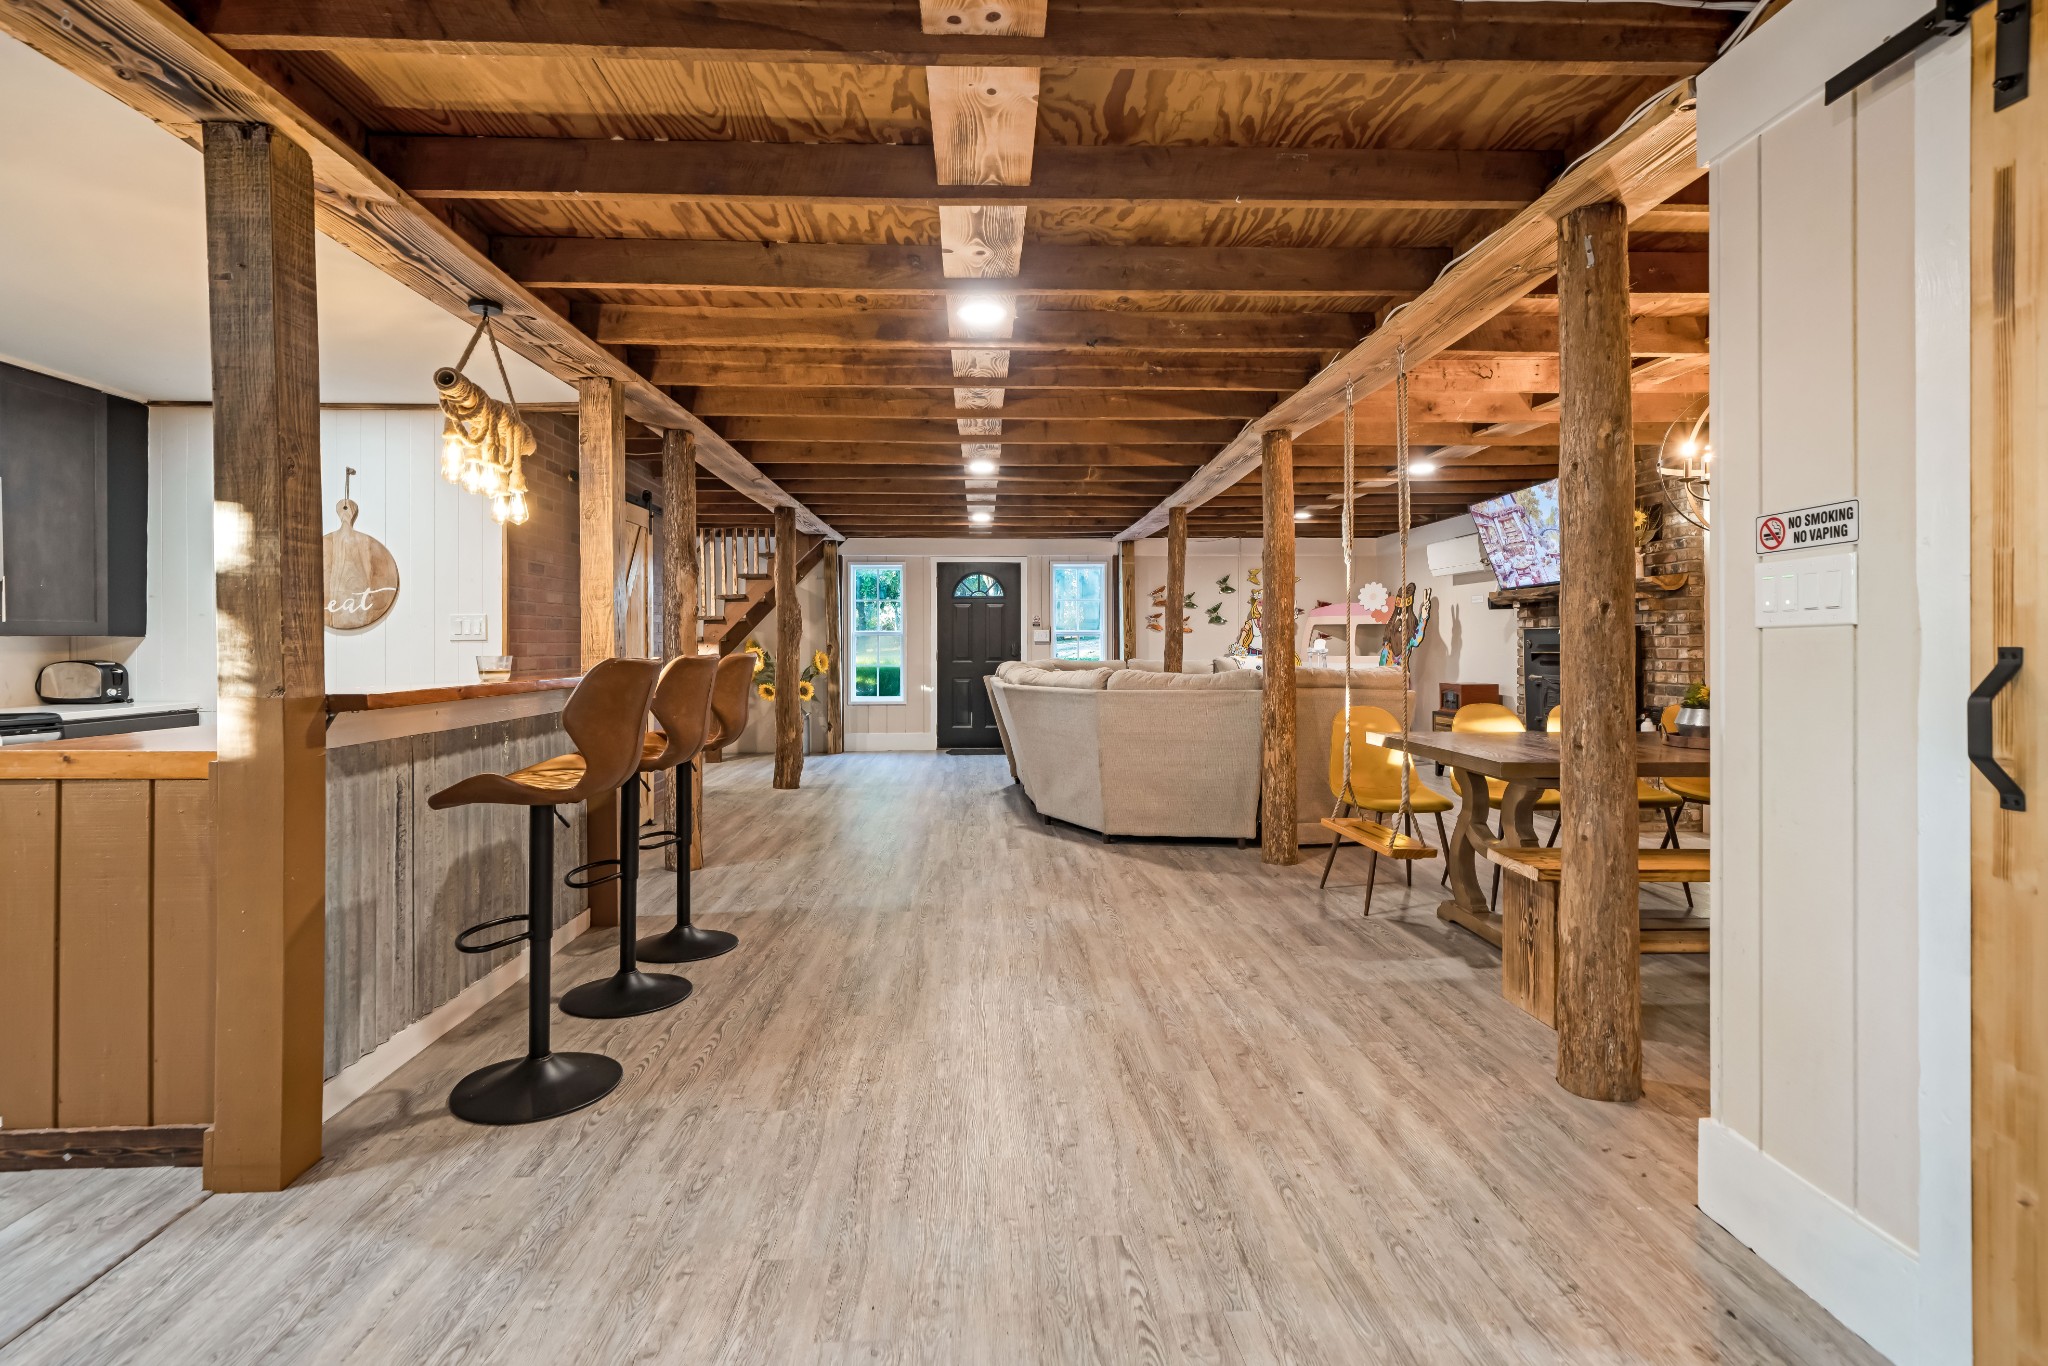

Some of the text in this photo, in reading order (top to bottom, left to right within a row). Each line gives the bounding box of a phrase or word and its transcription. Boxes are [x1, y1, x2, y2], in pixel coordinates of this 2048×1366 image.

[1788, 507, 1854, 529] NO SMOKING
[1793, 524, 1848, 543] NO VAPING
[324, 587, 398, 613] eat
